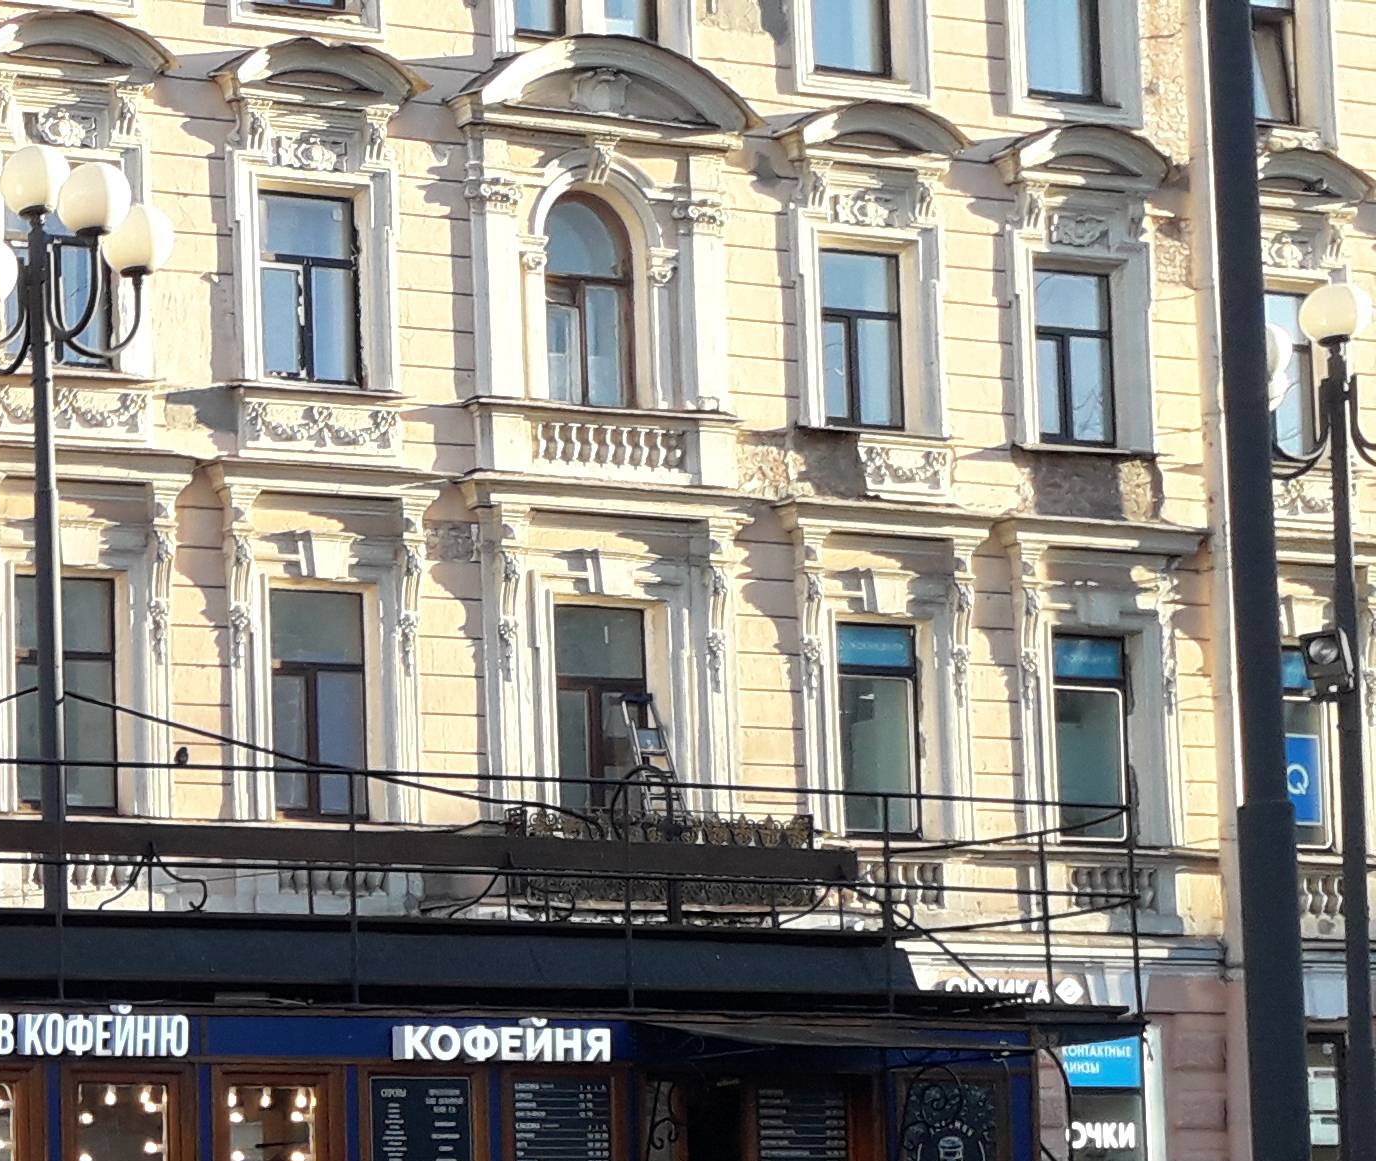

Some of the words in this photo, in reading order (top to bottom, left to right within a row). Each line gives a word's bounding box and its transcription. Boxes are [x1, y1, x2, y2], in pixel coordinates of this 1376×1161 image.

[18, 1003, 190, 1057] КОФЕЙНЮ
[394, 1017, 612, 1063] КОФЕЙНЯ
[1062, 1044, 1131, 1058] КОНТАКТНЫЕ
[1064, 1062, 1100, 1074] ЛИНЗЫ
[1066, 1121, 1136, 1149] ОЧКИ
